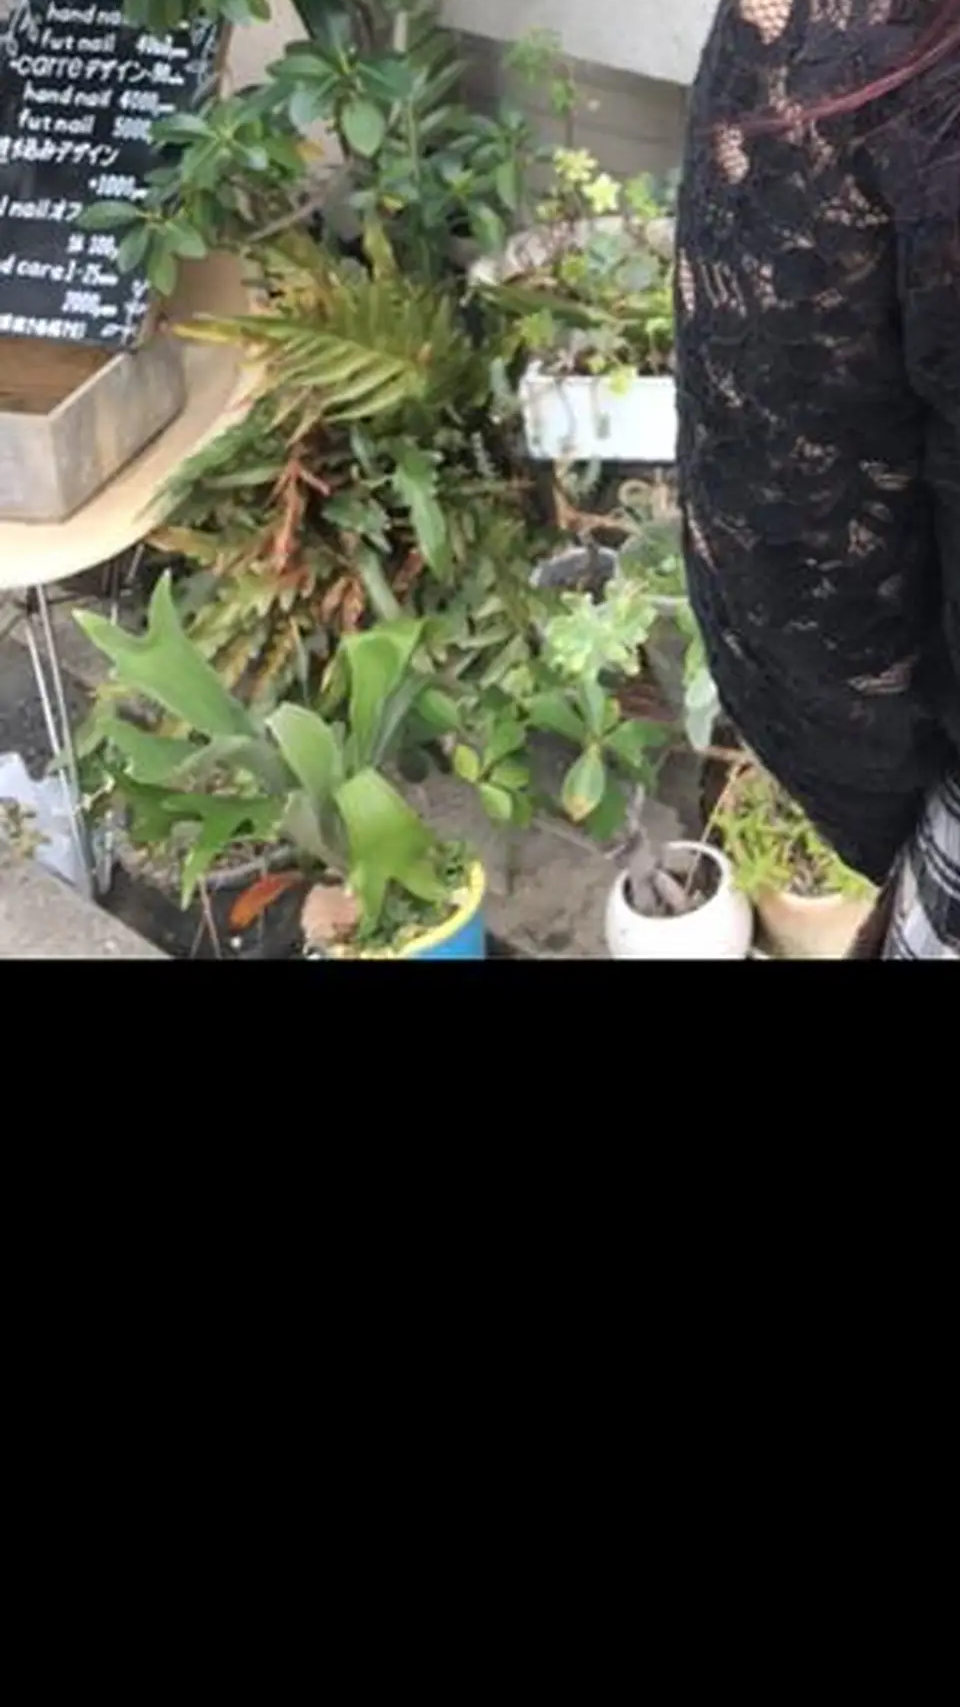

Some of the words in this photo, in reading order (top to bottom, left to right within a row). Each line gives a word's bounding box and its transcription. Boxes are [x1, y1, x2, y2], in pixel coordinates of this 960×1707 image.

[46, 1, 97, 24] hand
[77, 32, 117, 52] nail
[23, 80, 74, 104] hand
[74, 88, 114, 108] nail
[54, 114, 95, 135] nail
